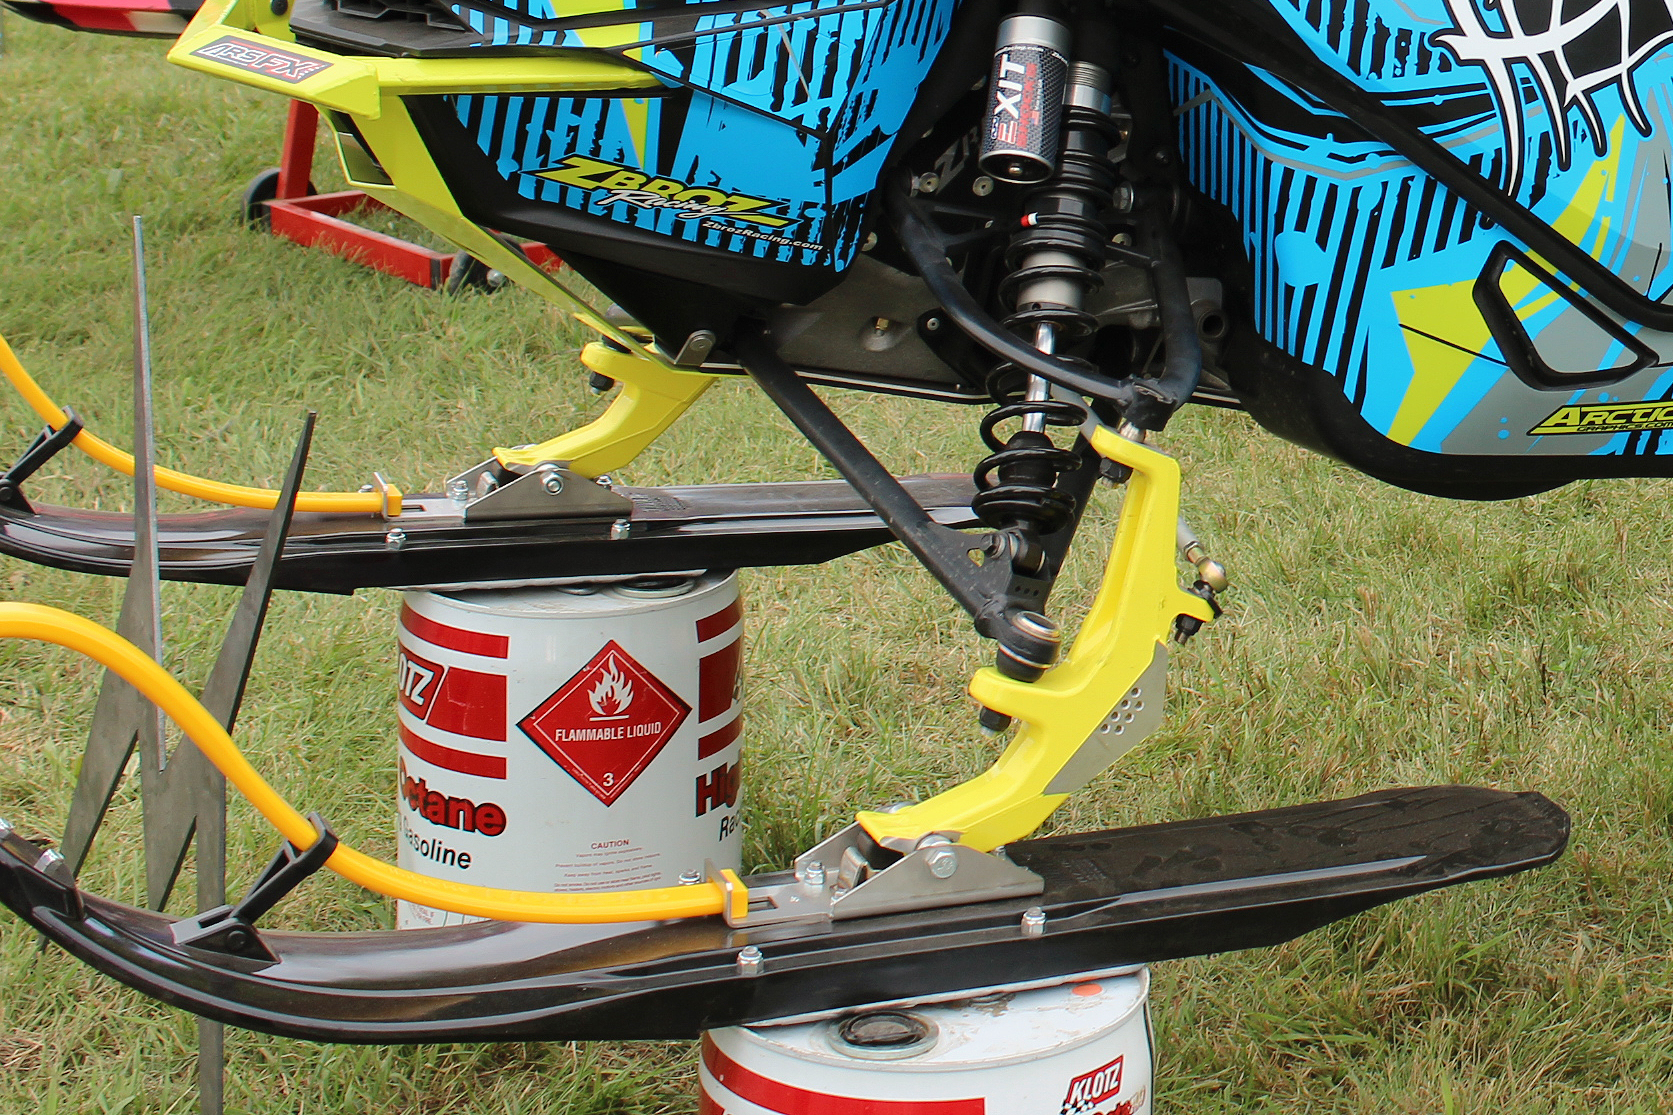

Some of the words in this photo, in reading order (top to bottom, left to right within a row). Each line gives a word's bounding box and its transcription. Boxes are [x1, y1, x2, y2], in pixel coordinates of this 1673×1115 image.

[994, 53, 1026, 145] EXIT
[534, 156, 790, 228] ZBROZ
[597, 189, 746, 220] Racing
[701, 220, 824, 252] ZbrozRacing.com
[554, 725, 625, 742] FLAMMABLE
[626, 721, 662, 739] LIQUID
[601, 771, 615, 788] 3
[590, 838, 630, 850] CAUTION
[1069, 1061, 1121, 1105] KLOTZ
